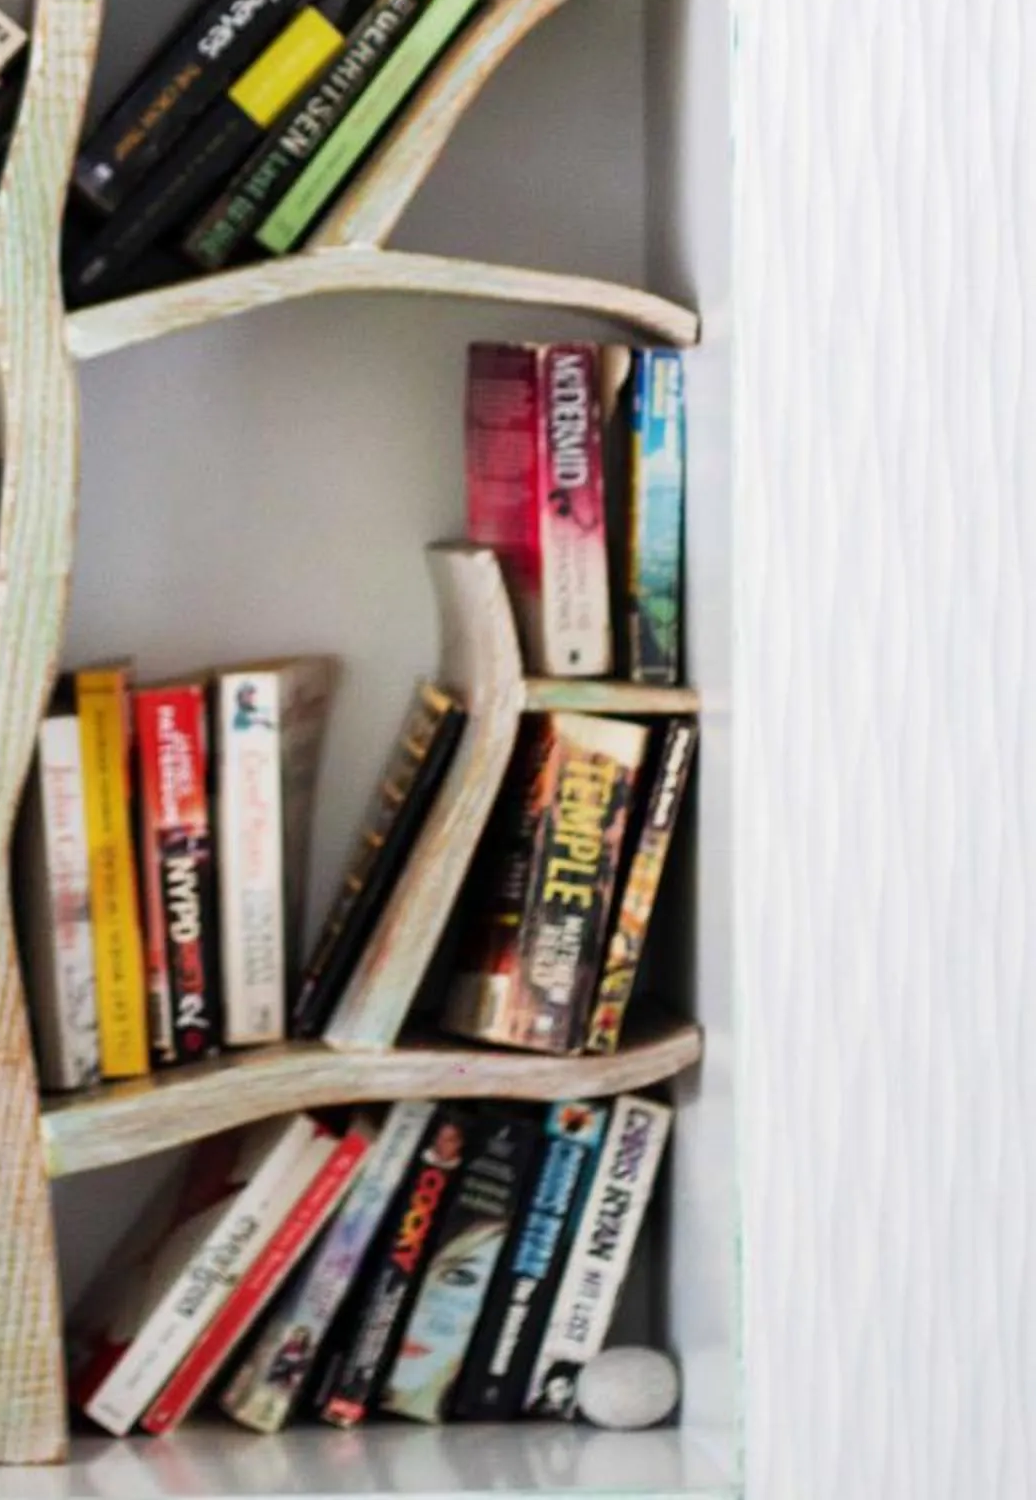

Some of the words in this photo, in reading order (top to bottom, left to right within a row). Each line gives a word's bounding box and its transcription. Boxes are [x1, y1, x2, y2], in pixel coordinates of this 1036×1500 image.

[275, 3, 408, 162] GERRITSEN
[536, 750, 622, 912] TEMPLE
[162, 855, 201, 944] NYPD
[584, 1182, 633, 1263] RYAN
